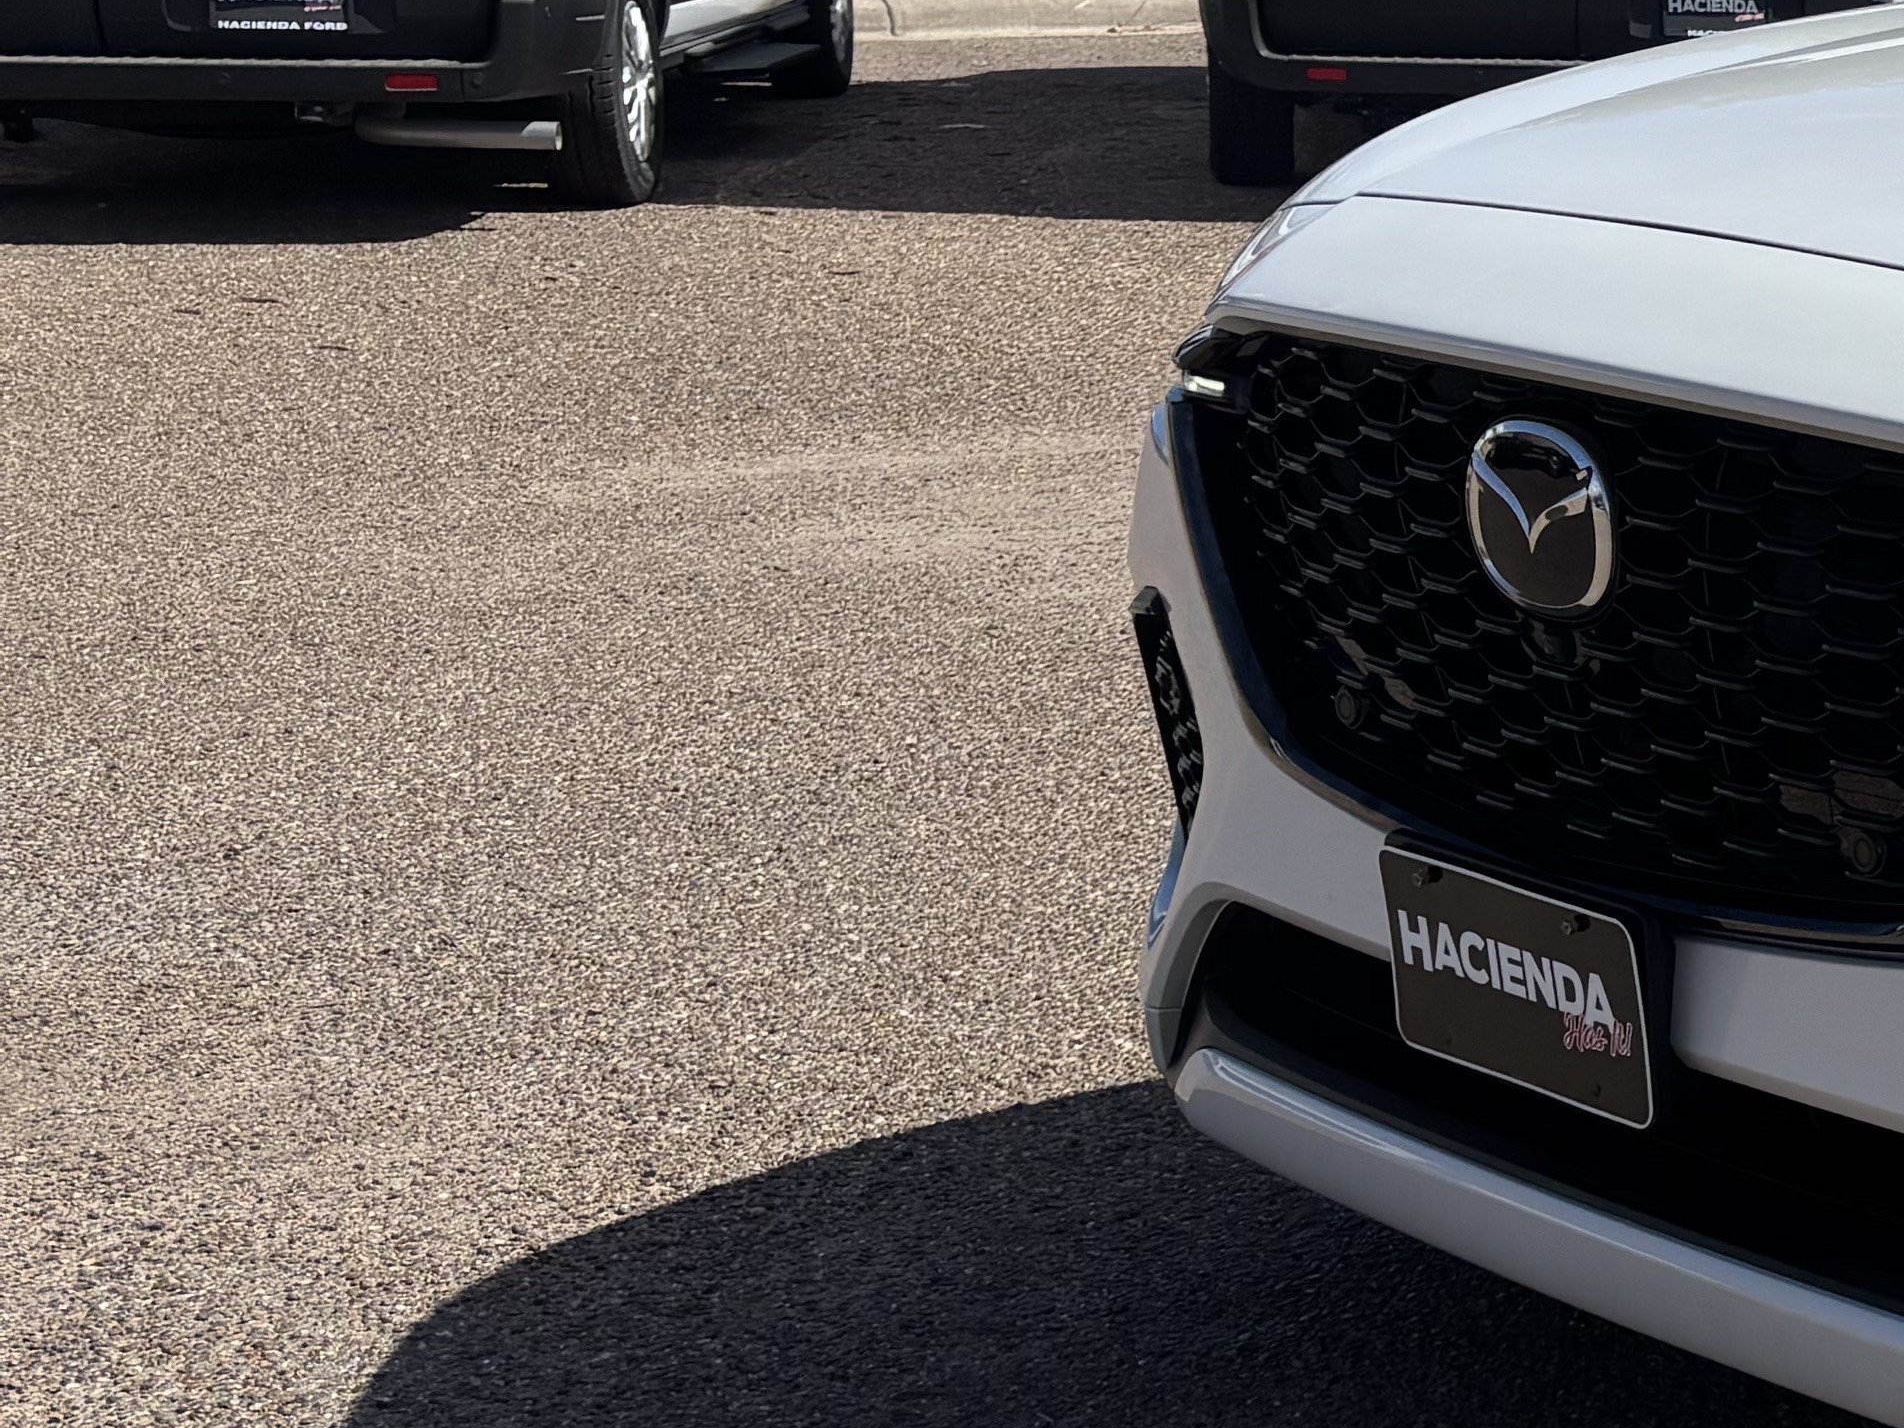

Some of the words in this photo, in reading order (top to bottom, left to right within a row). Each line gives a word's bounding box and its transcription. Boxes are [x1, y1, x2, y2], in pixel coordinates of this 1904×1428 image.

[217, 20, 301, 30] HACIENDA
[304, 20, 348, 31] FORD
[1397, 908, 1616, 1032] HACIENDA
[1562, 1011, 1608, 1052] Has
